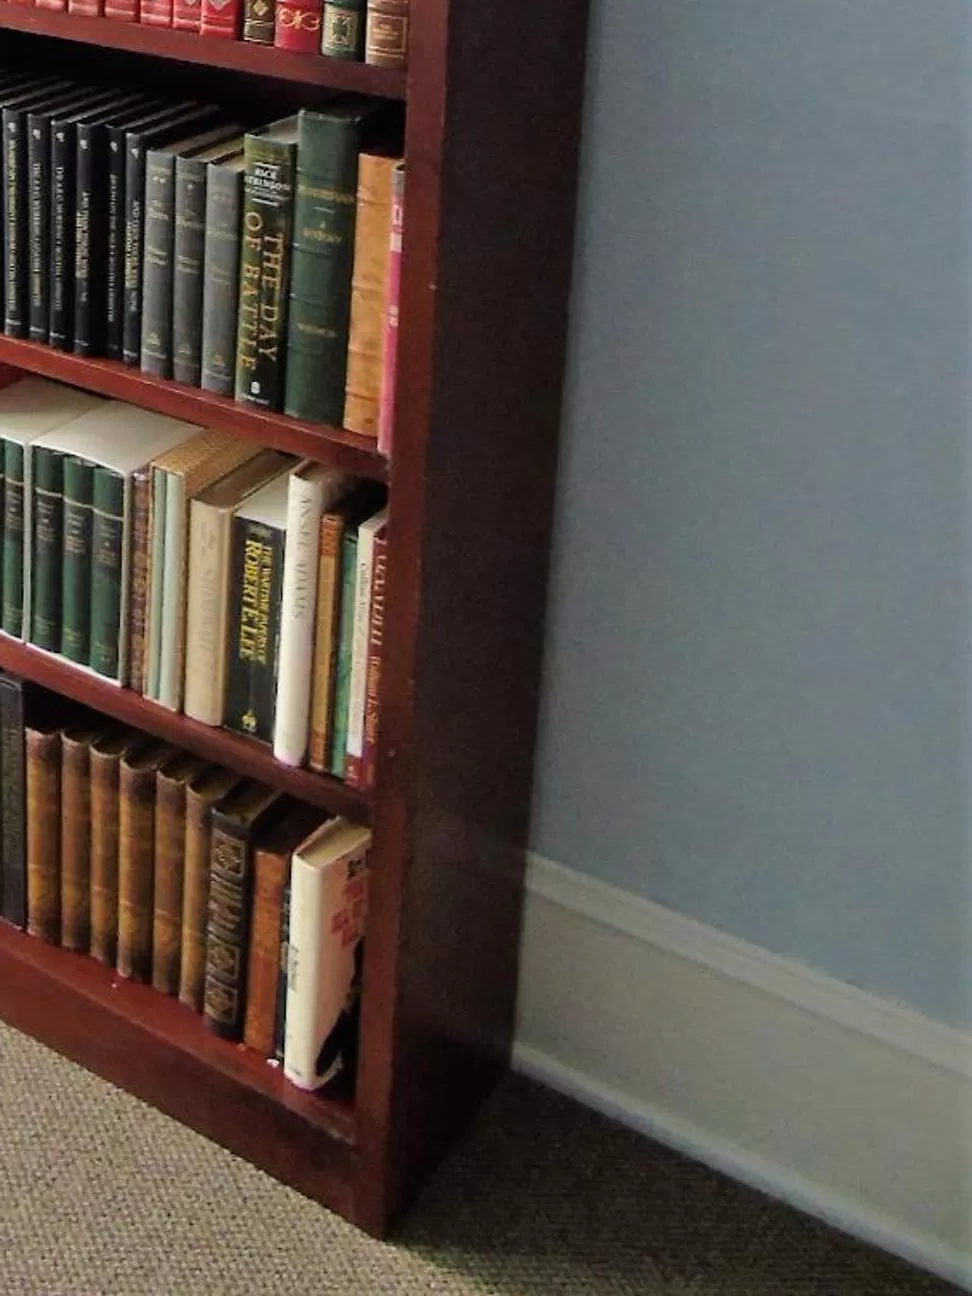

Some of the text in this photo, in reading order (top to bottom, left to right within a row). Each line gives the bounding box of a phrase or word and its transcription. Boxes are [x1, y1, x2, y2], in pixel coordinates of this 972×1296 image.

[238, 211, 263, 370] OF BATTLE
[258, 232, 284, 362] THE DAY
[241, 539, 263, 606] ROBERT
[239, 624, 259, 661] LEE
